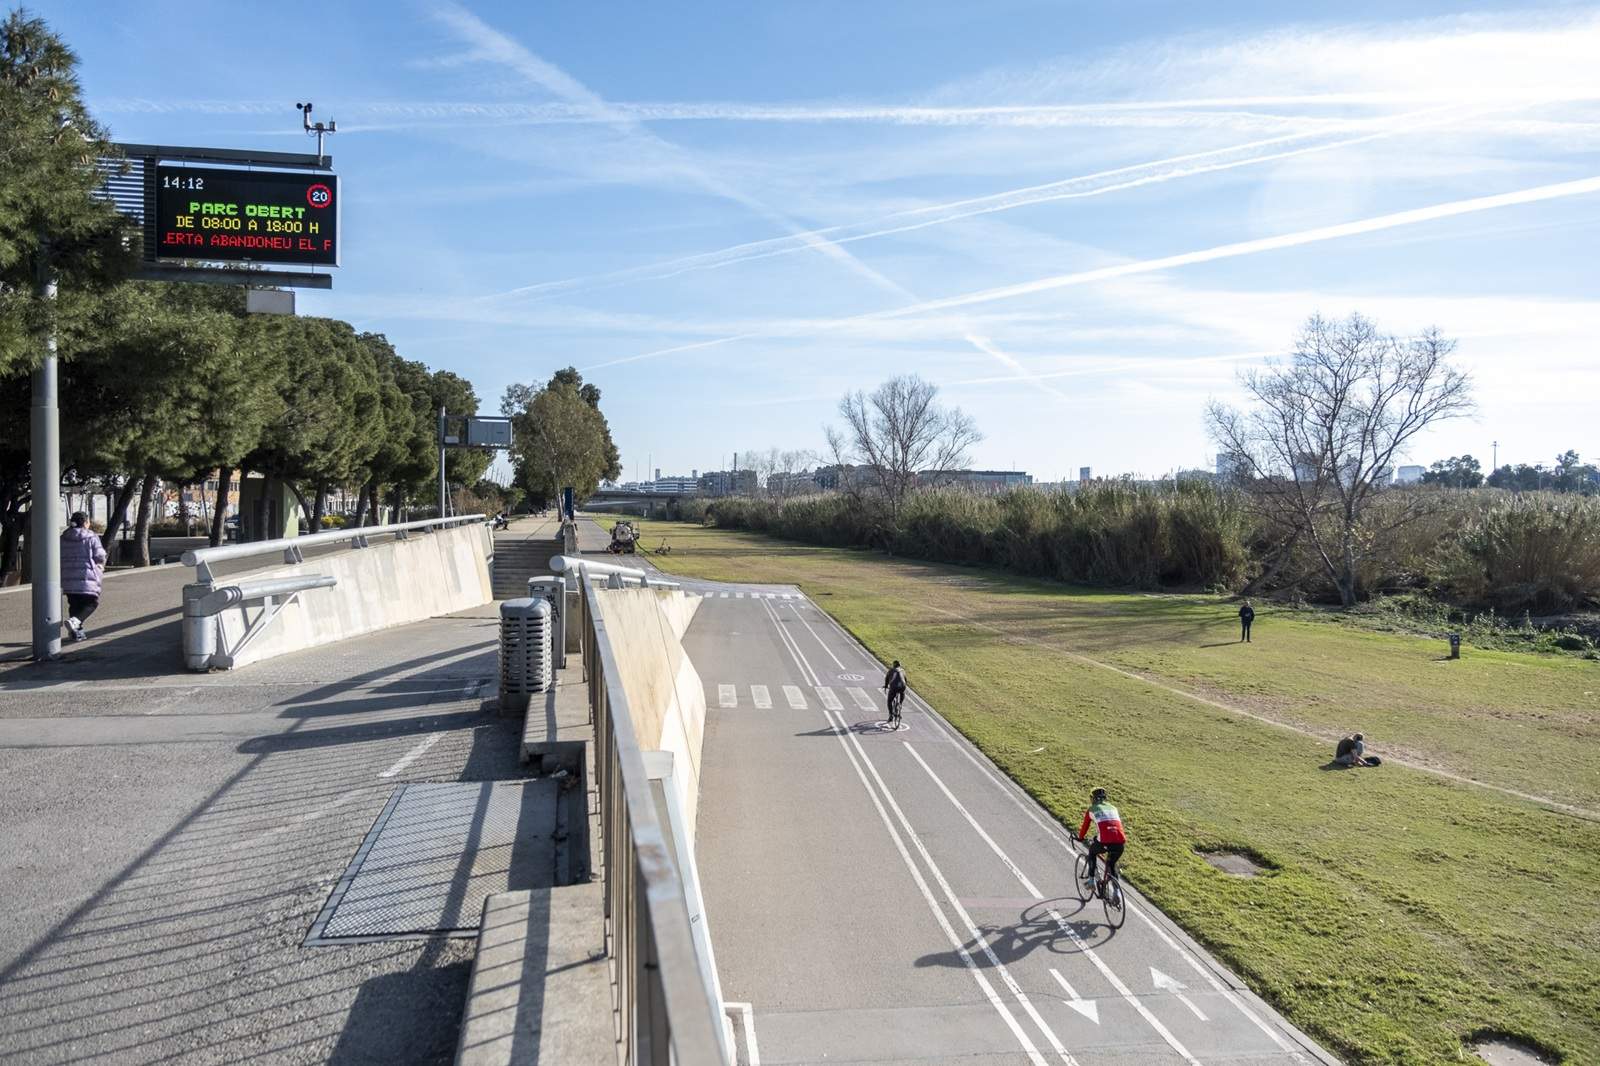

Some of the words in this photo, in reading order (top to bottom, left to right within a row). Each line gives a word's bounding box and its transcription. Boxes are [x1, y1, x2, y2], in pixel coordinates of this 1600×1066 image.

[163, 176, 204, 189] 14:12
[312, 191, 328, 202] 20
[189, 202, 239, 215] PARC
[245, 206, 306, 219] OBERT
[176, 215, 195, 228] DE
[201, 217, 241, 230] 08:00
[248, 219, 258, 231] A
[266, 221, 302, 233] 18:00
[309, 222, 319, 234] H
[163, 233, 204, 245] ERTA
[210, 235, 292, 249] ABANDONEU
[299, 239, 317, 250] EL
